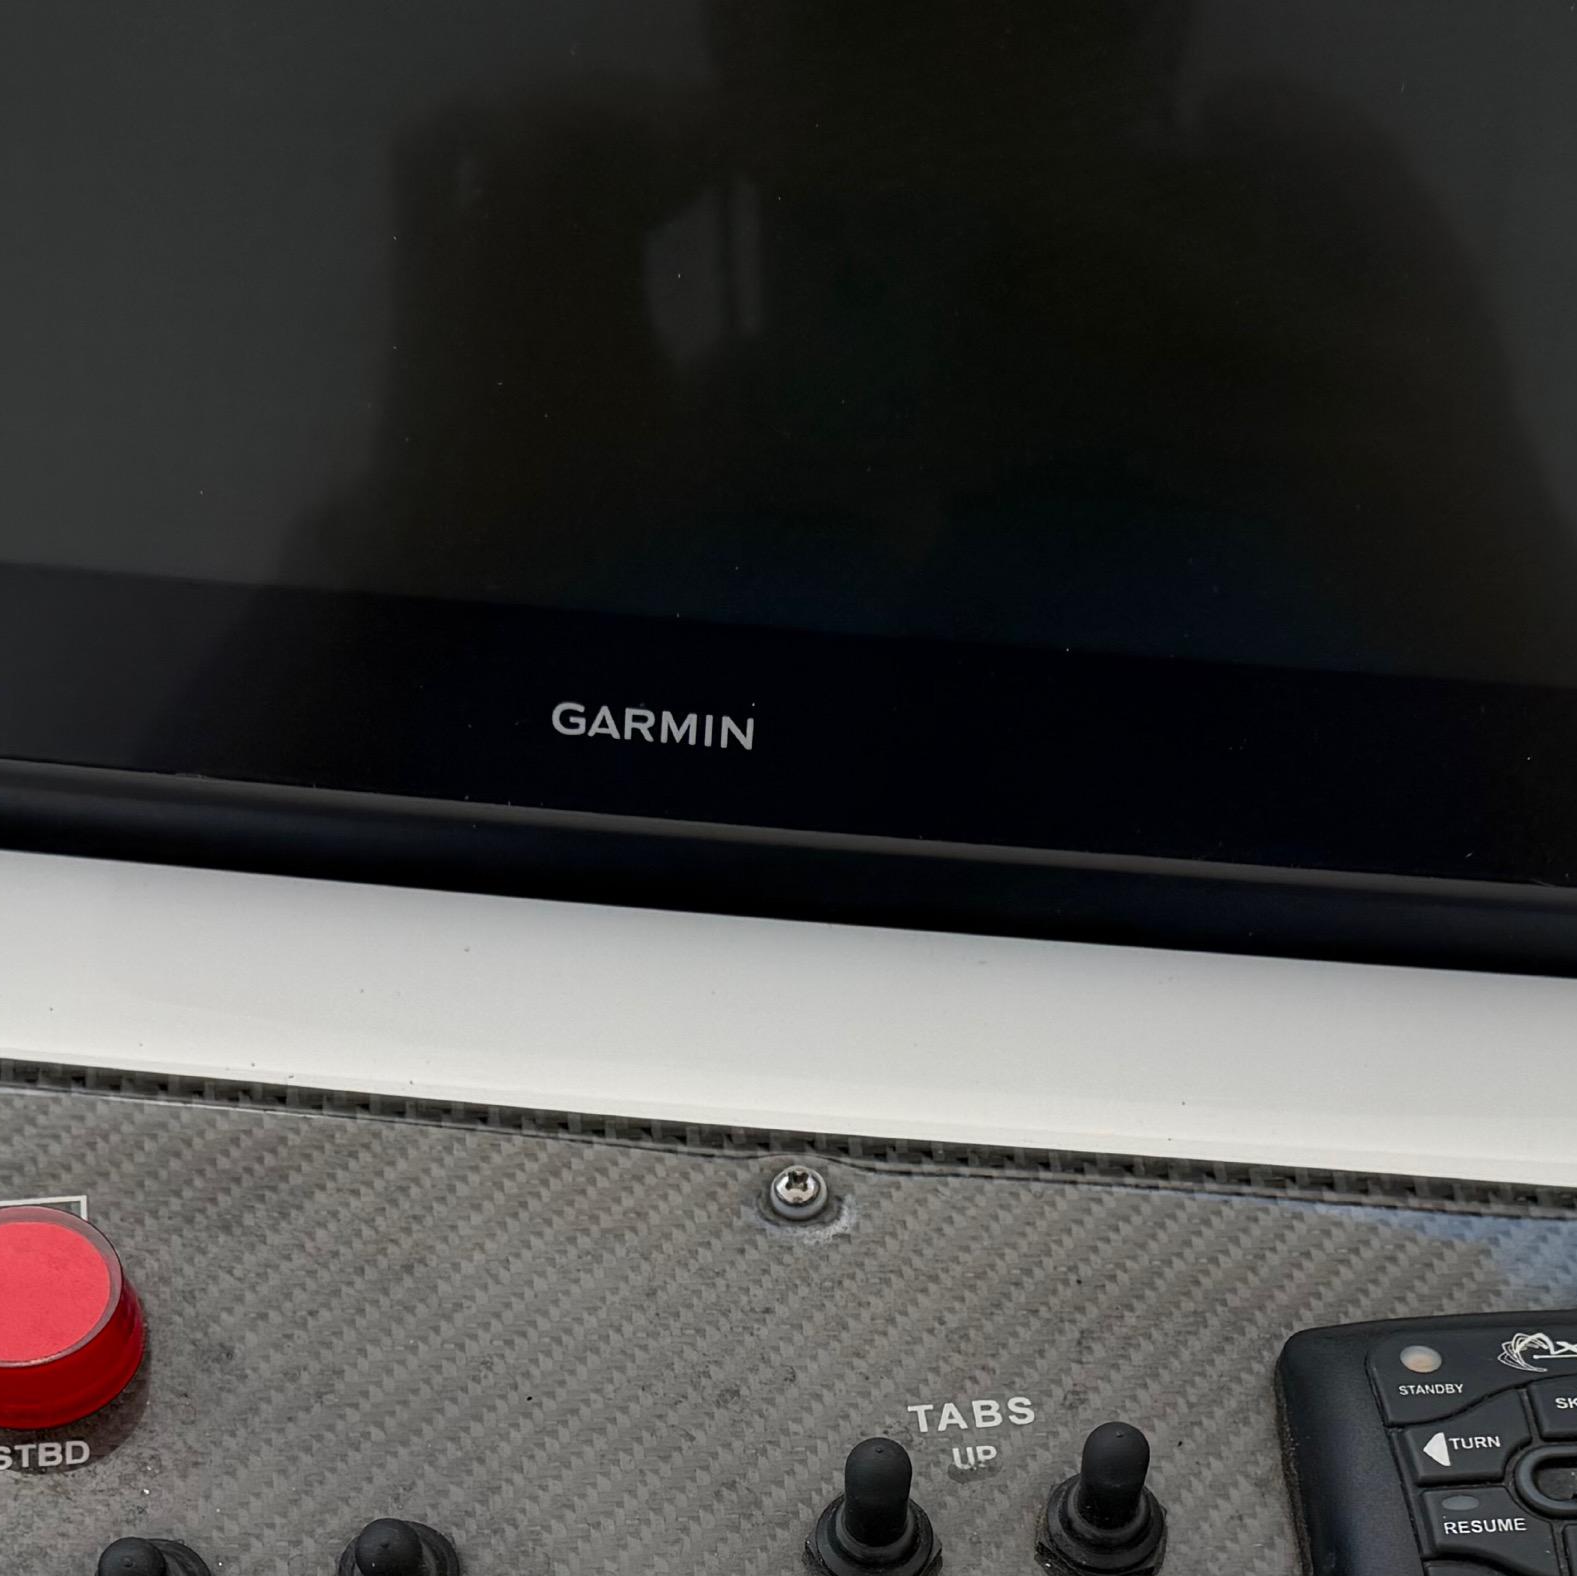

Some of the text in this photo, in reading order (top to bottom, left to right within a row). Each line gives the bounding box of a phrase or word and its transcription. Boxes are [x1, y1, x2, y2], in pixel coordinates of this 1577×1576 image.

[551, 701, 755, 750] GARMIN
[1398, 1382, 1464, 1397] STANDBY
[907, 1396, 1035, 1433] TABS
[1449, 1435, 1501, 1451] TURN
[952, 1445, 998, 1470] UP
[1443, 1516, 1528, 1535] RESUME
